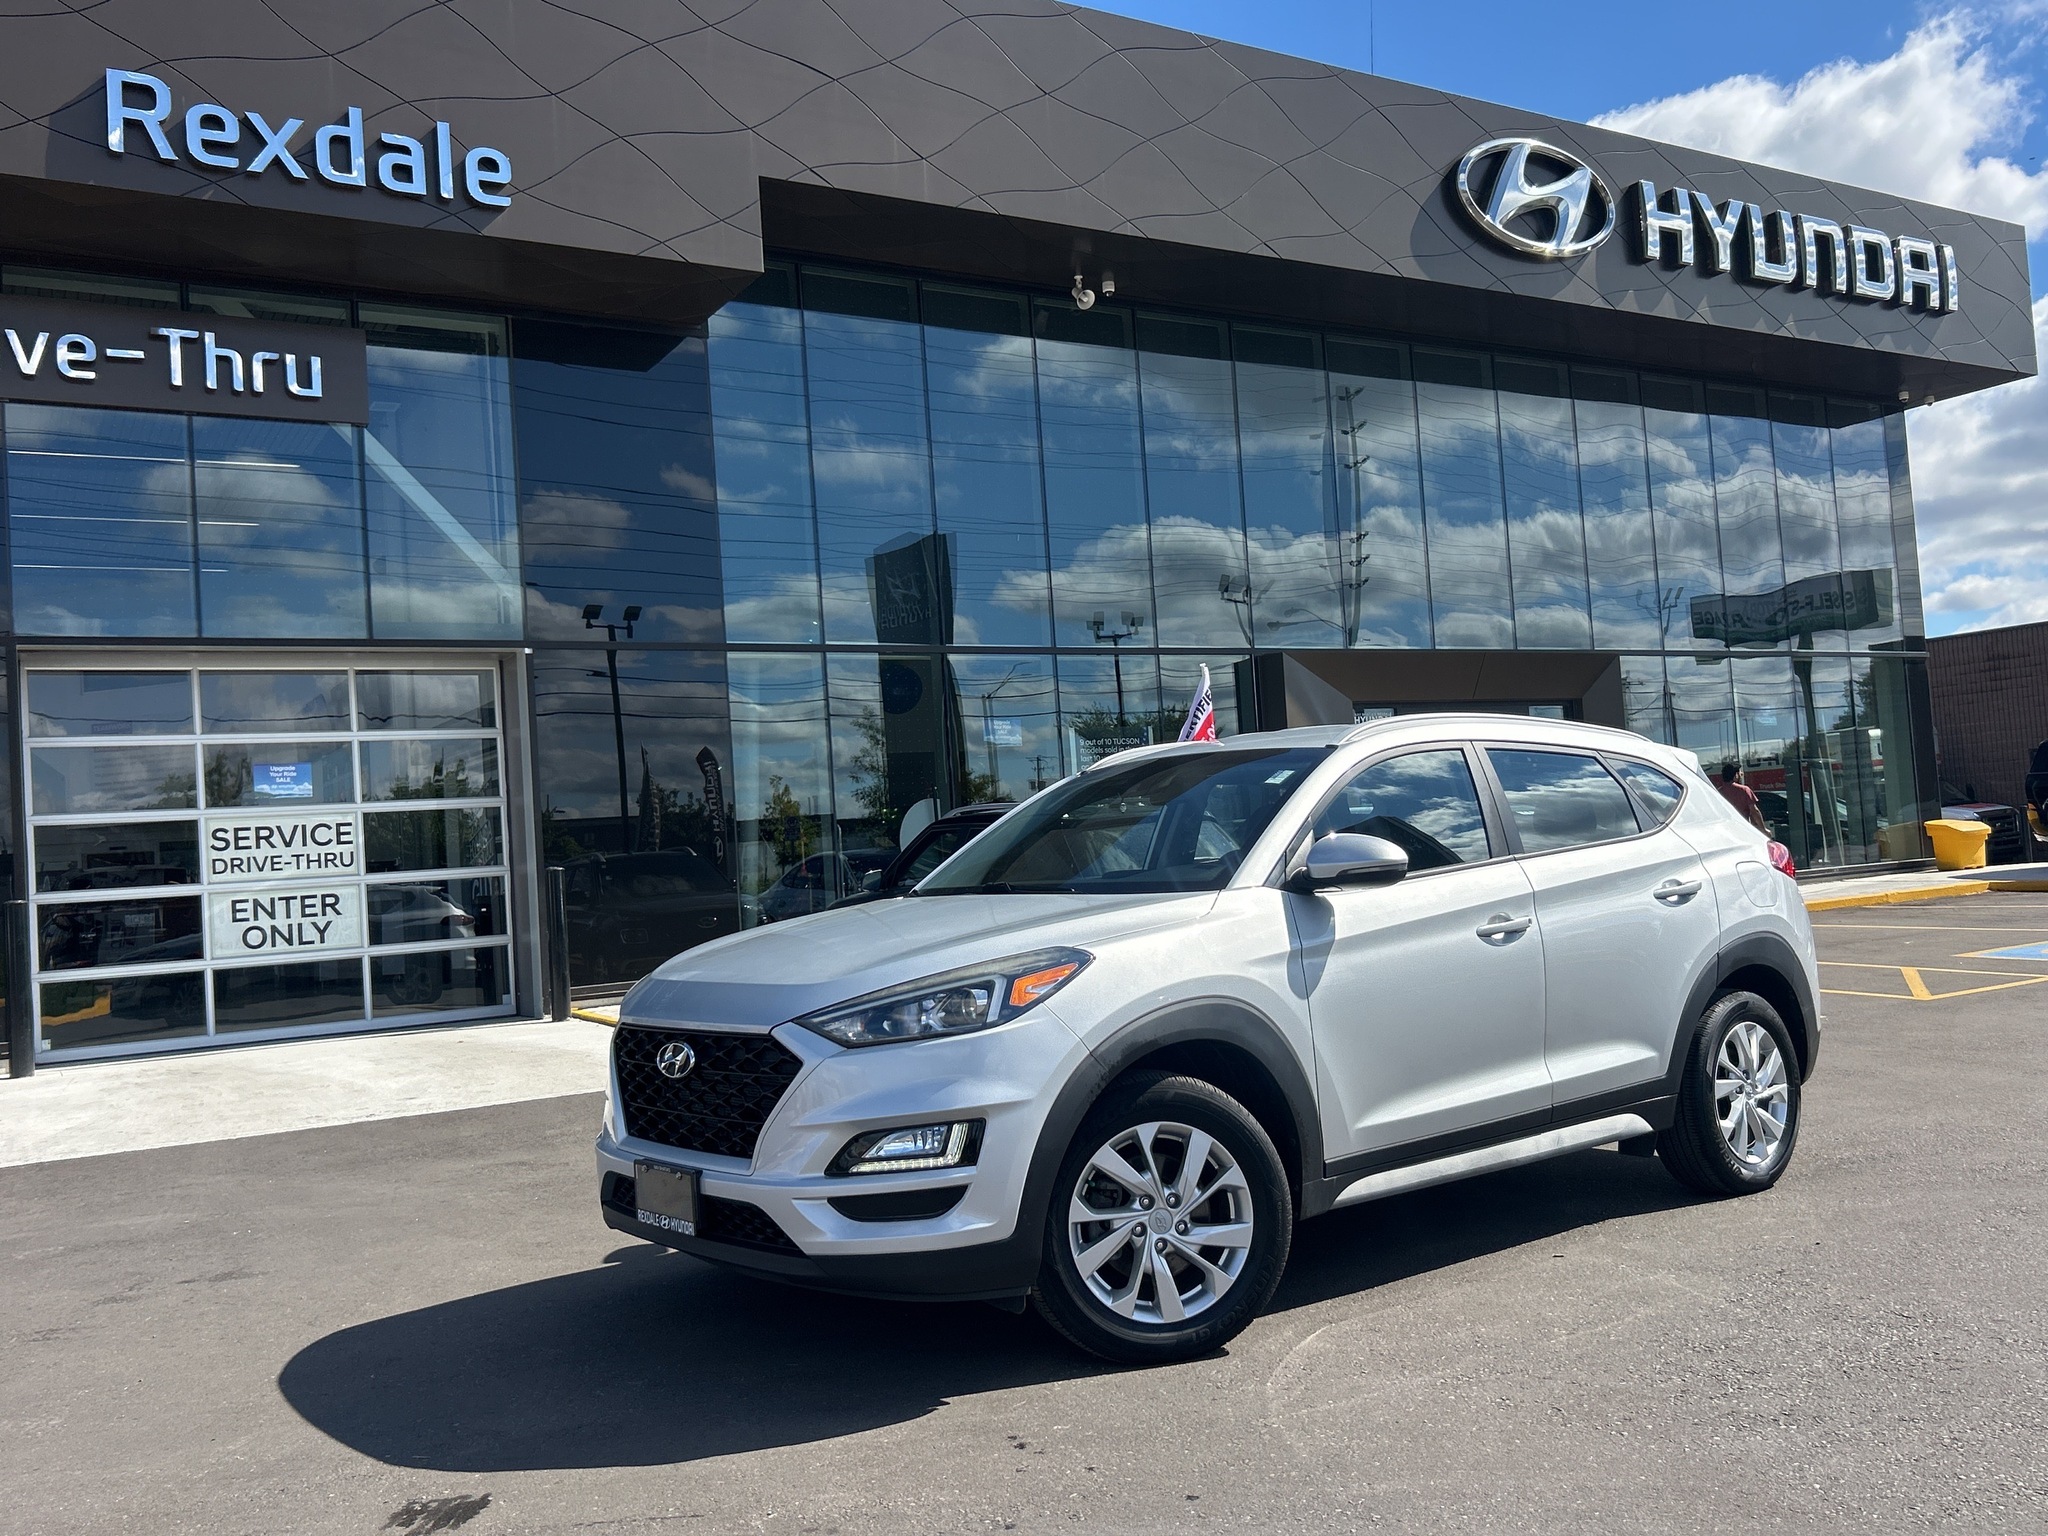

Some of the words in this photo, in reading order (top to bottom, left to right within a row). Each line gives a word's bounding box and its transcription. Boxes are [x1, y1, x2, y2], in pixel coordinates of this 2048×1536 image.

[106, 67, 512, 207] Rexdale
[1637, 178, 1959, 313] HYUNDAI
[1080, 738, 1085, 746] 9
[1112, 737, 1140, 745] TUCSON
[1105, 746, 1118, 754] sold
[210, 822, 354, 852] SERVICE
[211, 851, 355, 875] DRIVE-THRU
[231, 893, 343, 923] ENTER
[241, 920, 333, 950] ONLY
[637, 1208, 660, 1227] REXDALE
[670, 1216, 695, 1237] HYUNDAI
